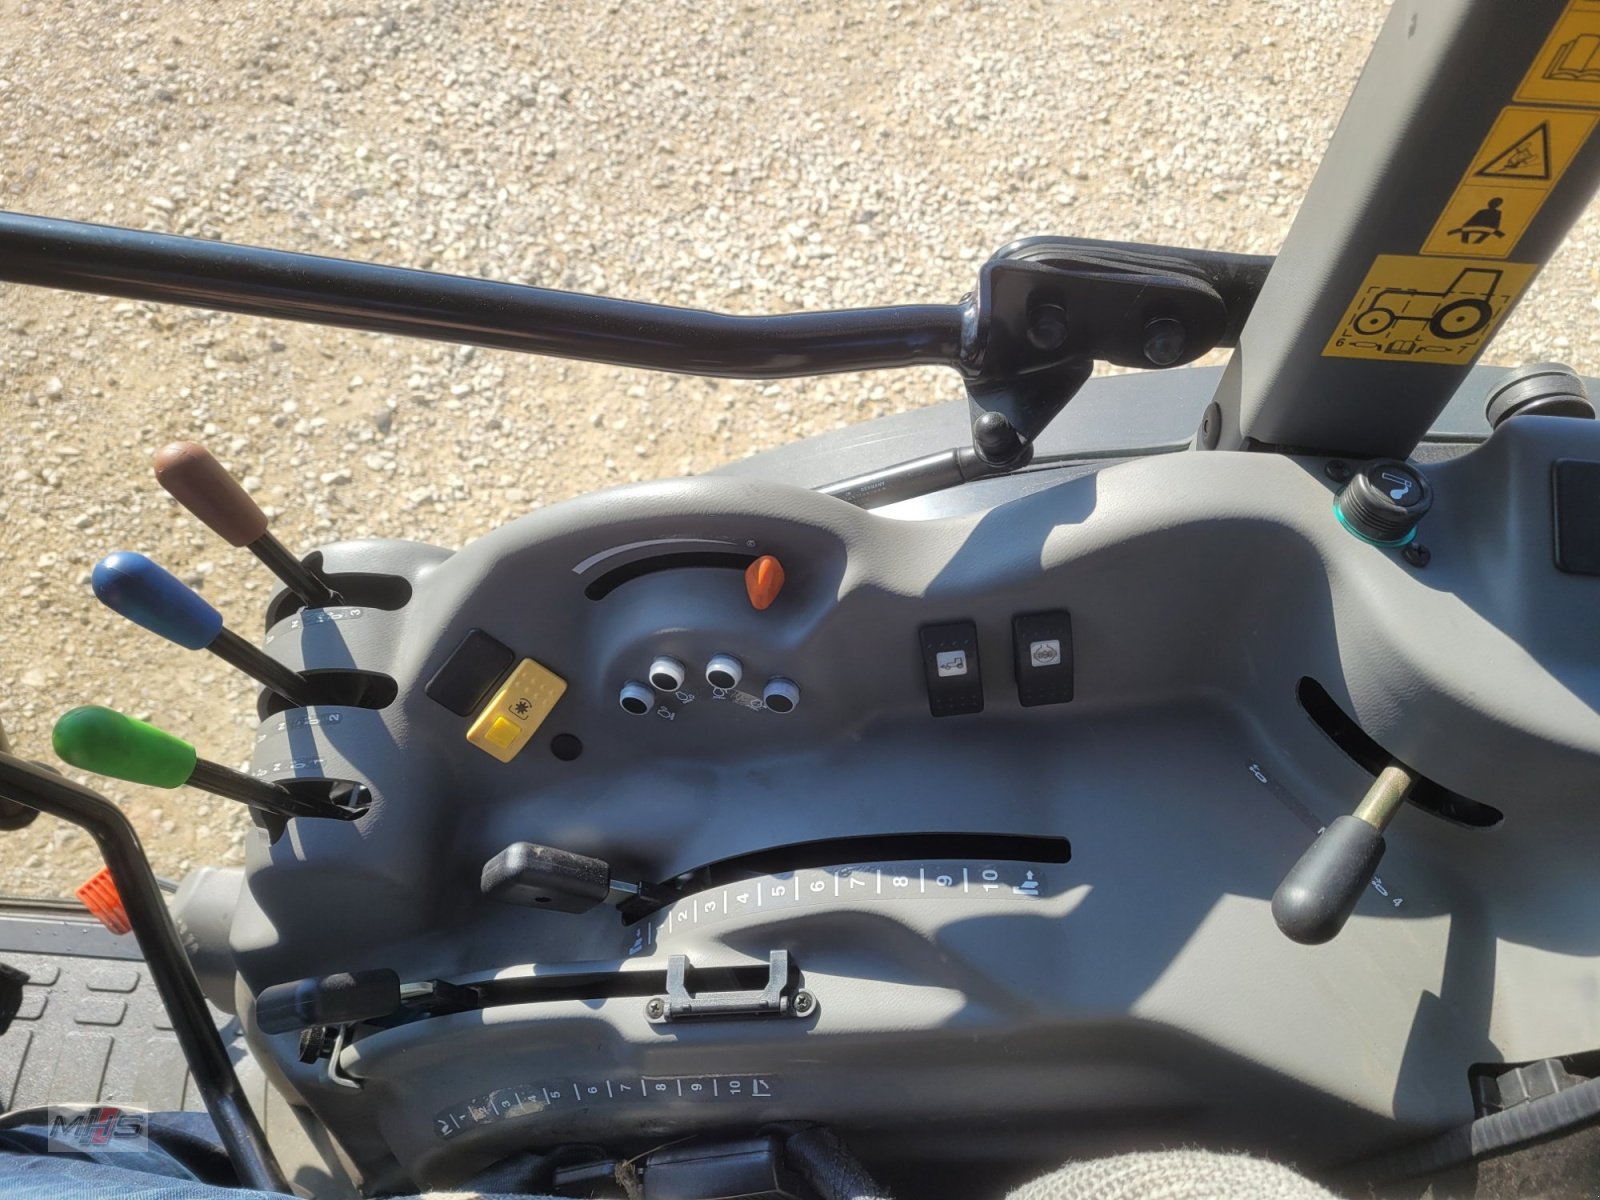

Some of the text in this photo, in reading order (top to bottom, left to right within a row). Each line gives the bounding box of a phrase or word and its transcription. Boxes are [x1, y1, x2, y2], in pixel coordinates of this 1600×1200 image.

[1336, 338, 1346, 347] 6
[350, 609, 361, 617] 3
[329, 713, 340, 722] 2
[677, 909, 688, 922] 2
[704, 901, 716, 912] 3
[736, 892, 750, 904] 4
[771, 885, 786, 897] 5
[810, 880, 825, 892] 6
[850, 878, 866, 889] 7
[892, 876, 909, 887] 8
[936, 875, 953, 887] 9
[982, 869, 999, 892] 10
[1392, 897, 1403, 907] 4
[501, 1100, 511, 1108] 3
[527, 1094, 538, 1103] 4
[550, 1091, 561, 1099] 5
[587, 1086, 598, 1094] 6
[620, 1084, 632, 1092] 7
[655, 1083, 667, 1091] 8
[690, 1083, 703, 1091] 9
[730, 1080, 741, 1095] 10
